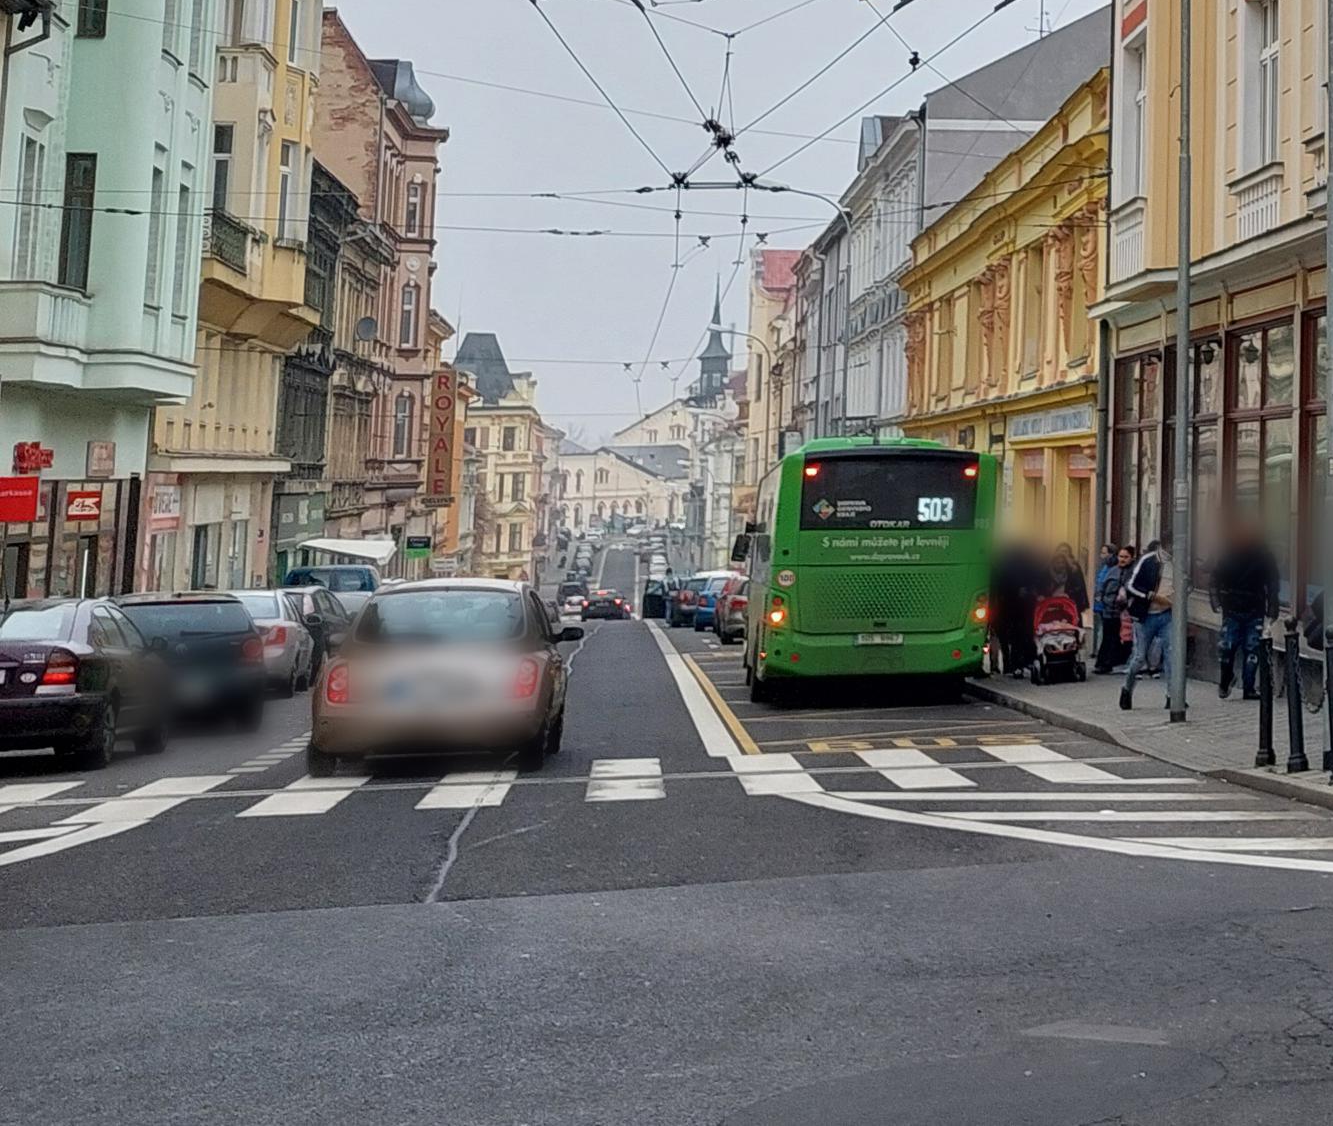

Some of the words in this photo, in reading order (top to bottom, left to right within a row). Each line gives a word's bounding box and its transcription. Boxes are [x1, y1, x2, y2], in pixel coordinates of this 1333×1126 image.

[432, 374, 452, 495] ROYALE
[917, 497, 954, 522] 503
[869, 520, 911, 528] OTOKAR
[822, 537, 830, 548] S
[832, 536, 859, 548] námi
[861, 536, 899, 547] můžete
[901, 536, 915, 550] jet
